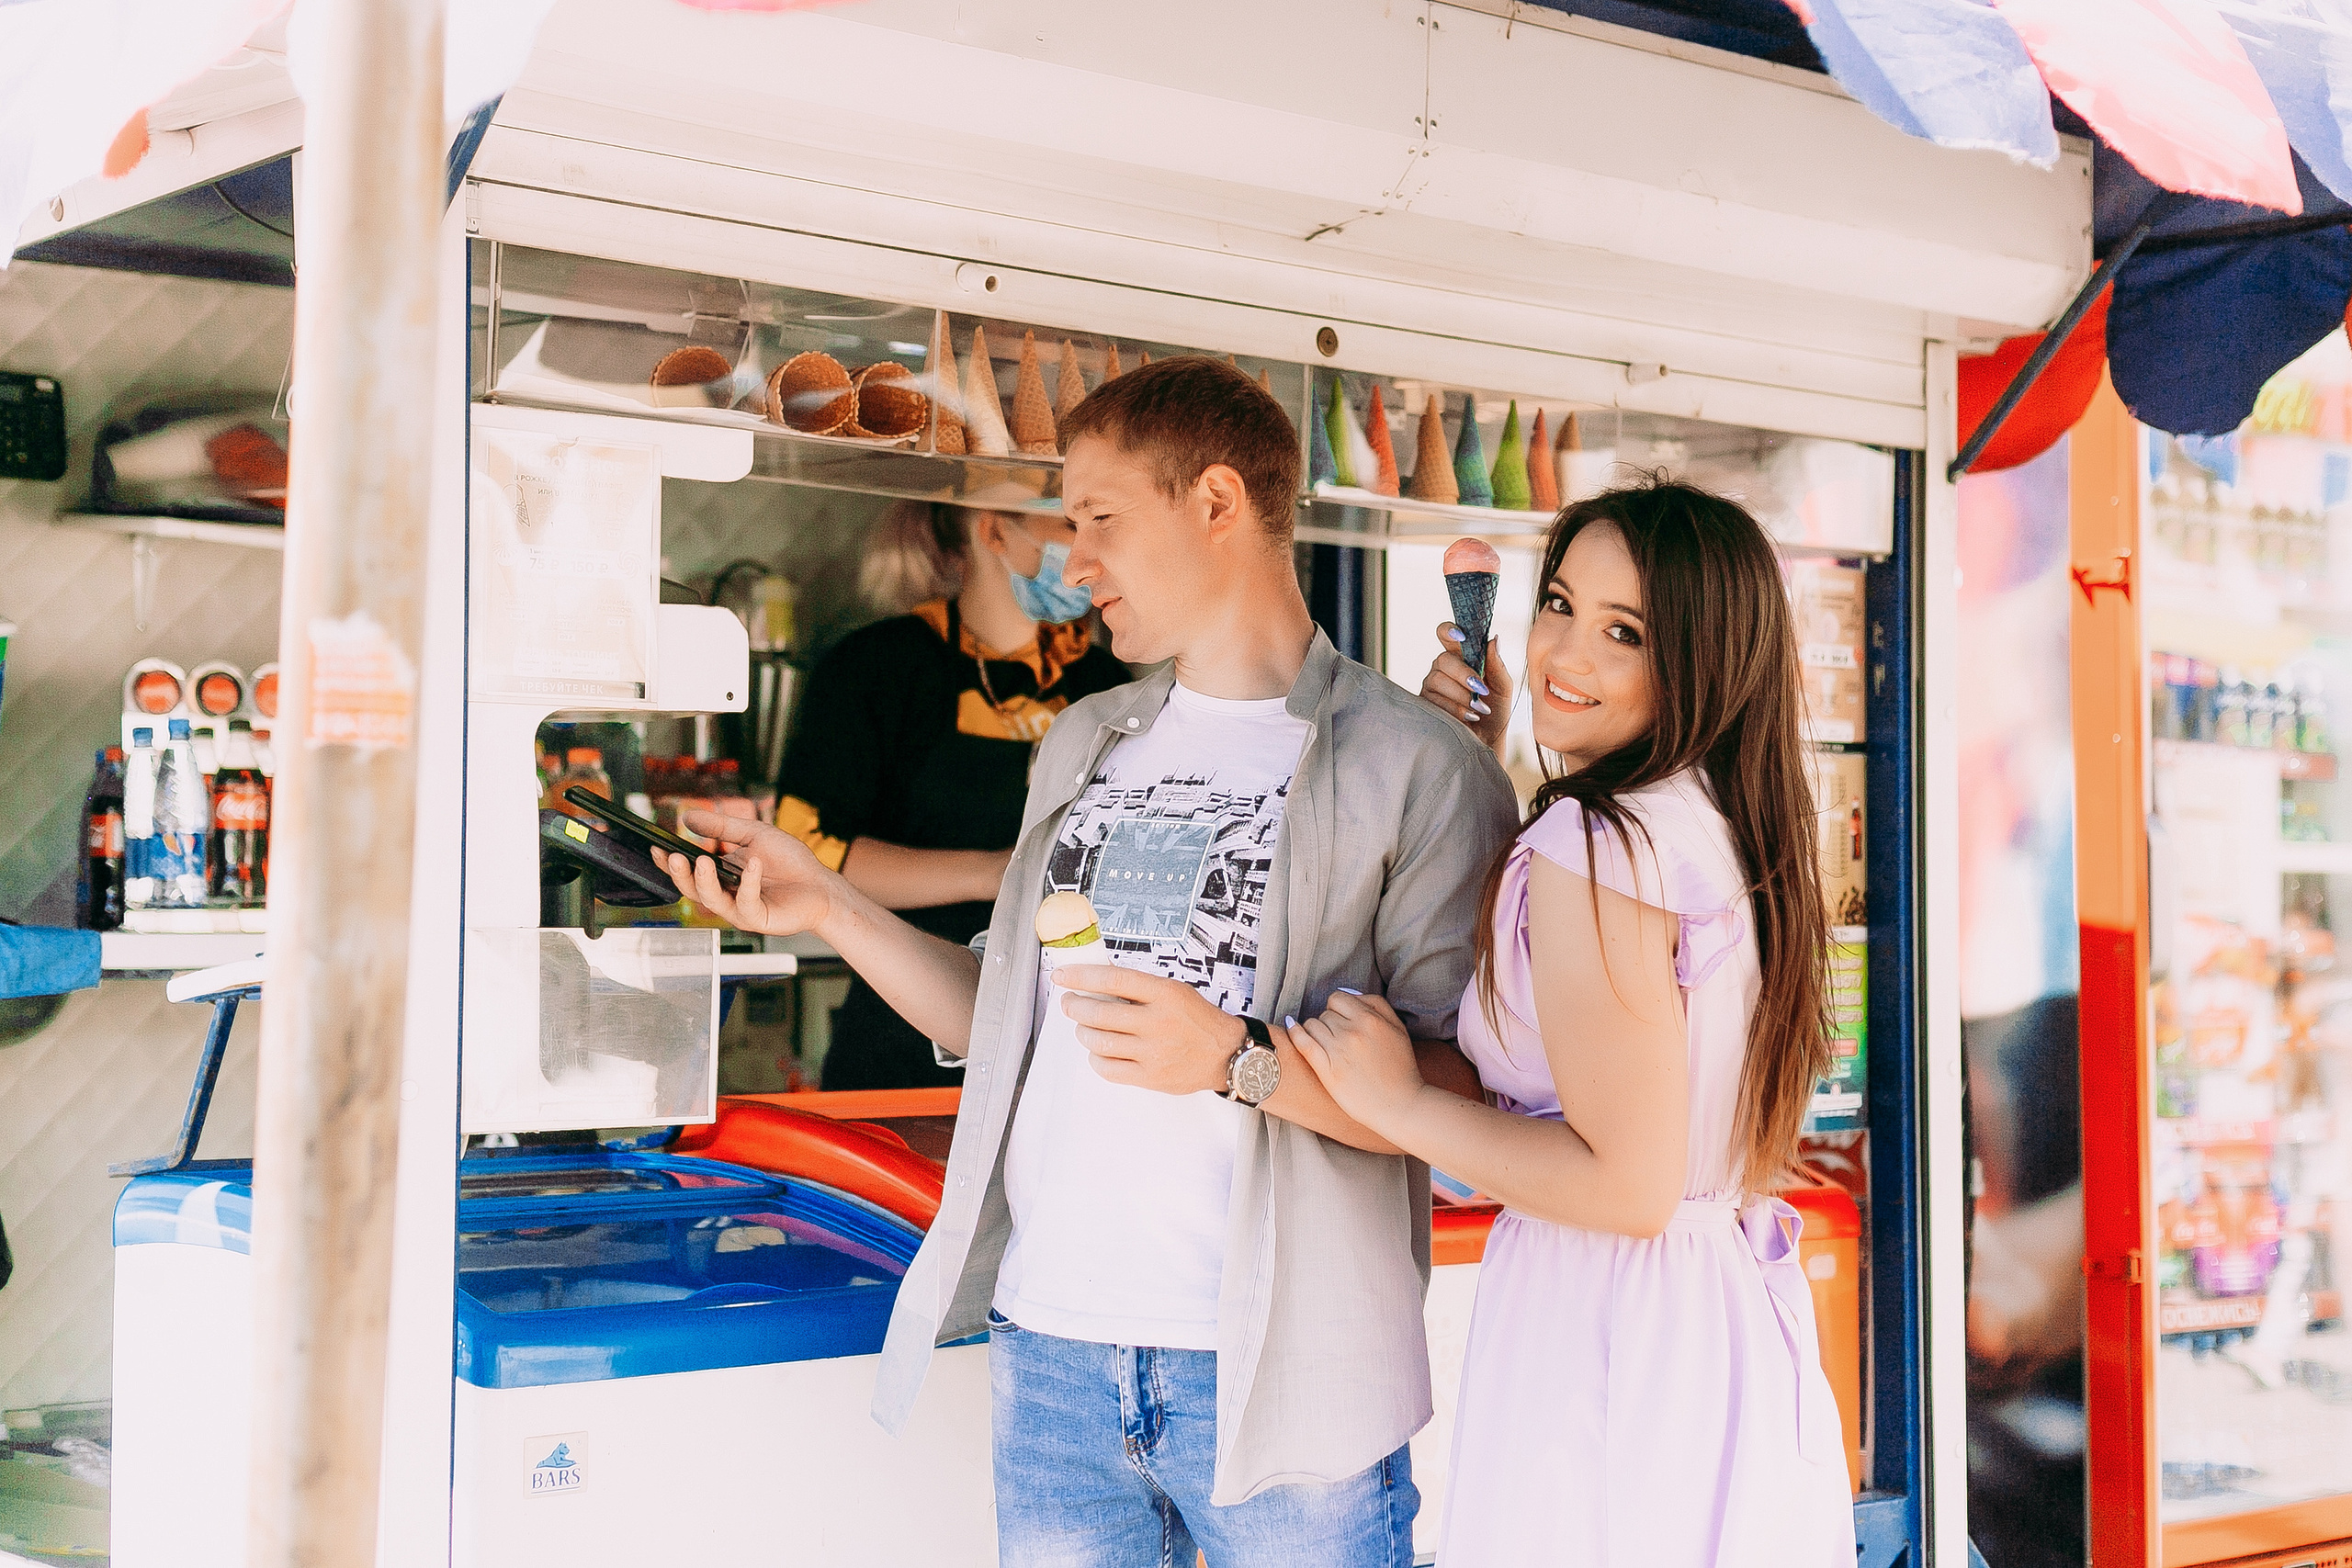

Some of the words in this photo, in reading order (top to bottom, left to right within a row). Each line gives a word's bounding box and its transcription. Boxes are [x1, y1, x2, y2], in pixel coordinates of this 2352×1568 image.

[520, 474, 548, 484] РОЖКЕ
[537, 488, 553, 496] ИЛИ
[529, 557, 545, 570] 75
[570, 560, 594, 573] 150
[520, 680, 579, 694] ТРЕБУЙТЕ
[582, 683, 604, 694] ЧЕК
[1108, 868, 1157, 882] MOVE
[1166, 873, 1187, 882] UP
[532, 1467, 581, 1490] BARS
